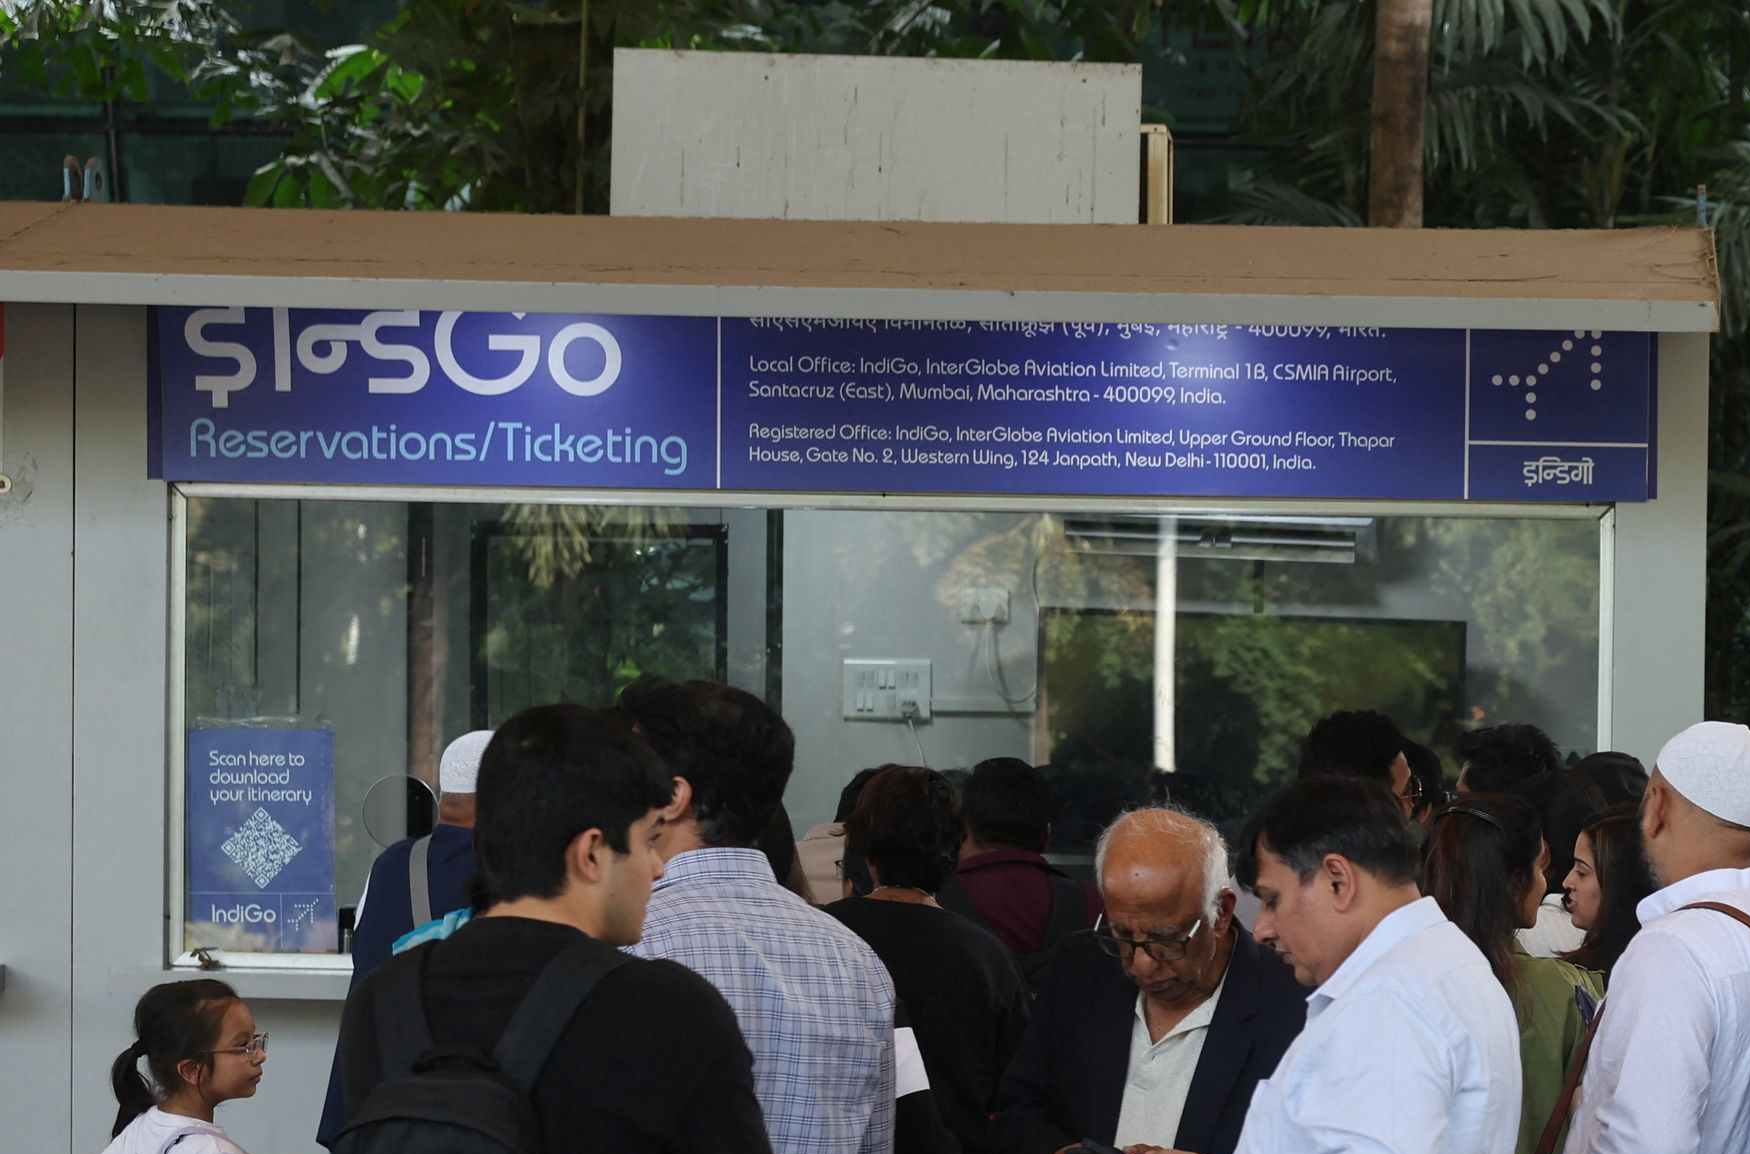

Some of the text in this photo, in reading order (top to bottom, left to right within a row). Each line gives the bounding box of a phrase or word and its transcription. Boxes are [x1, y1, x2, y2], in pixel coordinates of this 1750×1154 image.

[749, 356, 1398, 386] Local Office: IndiGo, InterGlobe Aviation Limited, Terminal 1B, CSMIA Airport,
[749, 380, 835, 399] Santacruz
[840, 382, 895, 402] (East),
[900, 383, 974, 402] Mumbai,
[978, 384, 1091, 402] Maharashtra
[1103, 386, 1176, 405] 400099,
[1180, 387, 1227, 404] India.
[188, 418, 688, 476] Reservations/Ticketing
[749, 423, 1396, 452] Registered Office: IndiGo, InterGlobe Aviation Limited, Upper Ground Floor, Thapar
[749, 446, 804, 464] House,
[806, 446, 849, 464] Gate
[852, 447, 879, 464] No.
[882, 448, 898, 466] 2,
[901, 449, 970, 465] Western
[972, 449, 1018, 470] Wing,
[1021, 450, 1050, 466] 124
[1052, 450, 1121, 470] Janpath,
[1125, 452, 1162, 467] New
[1272, 453, 1317, 470] India.
[1523, 456, 1595, 487] इन्डिगो
[208, 751, 305, 767] Scan here to
[209, 769, 290, 785] download
[209, 787, 313, 806] your itinerary
[211, 903, 277, 924] IndiGo
